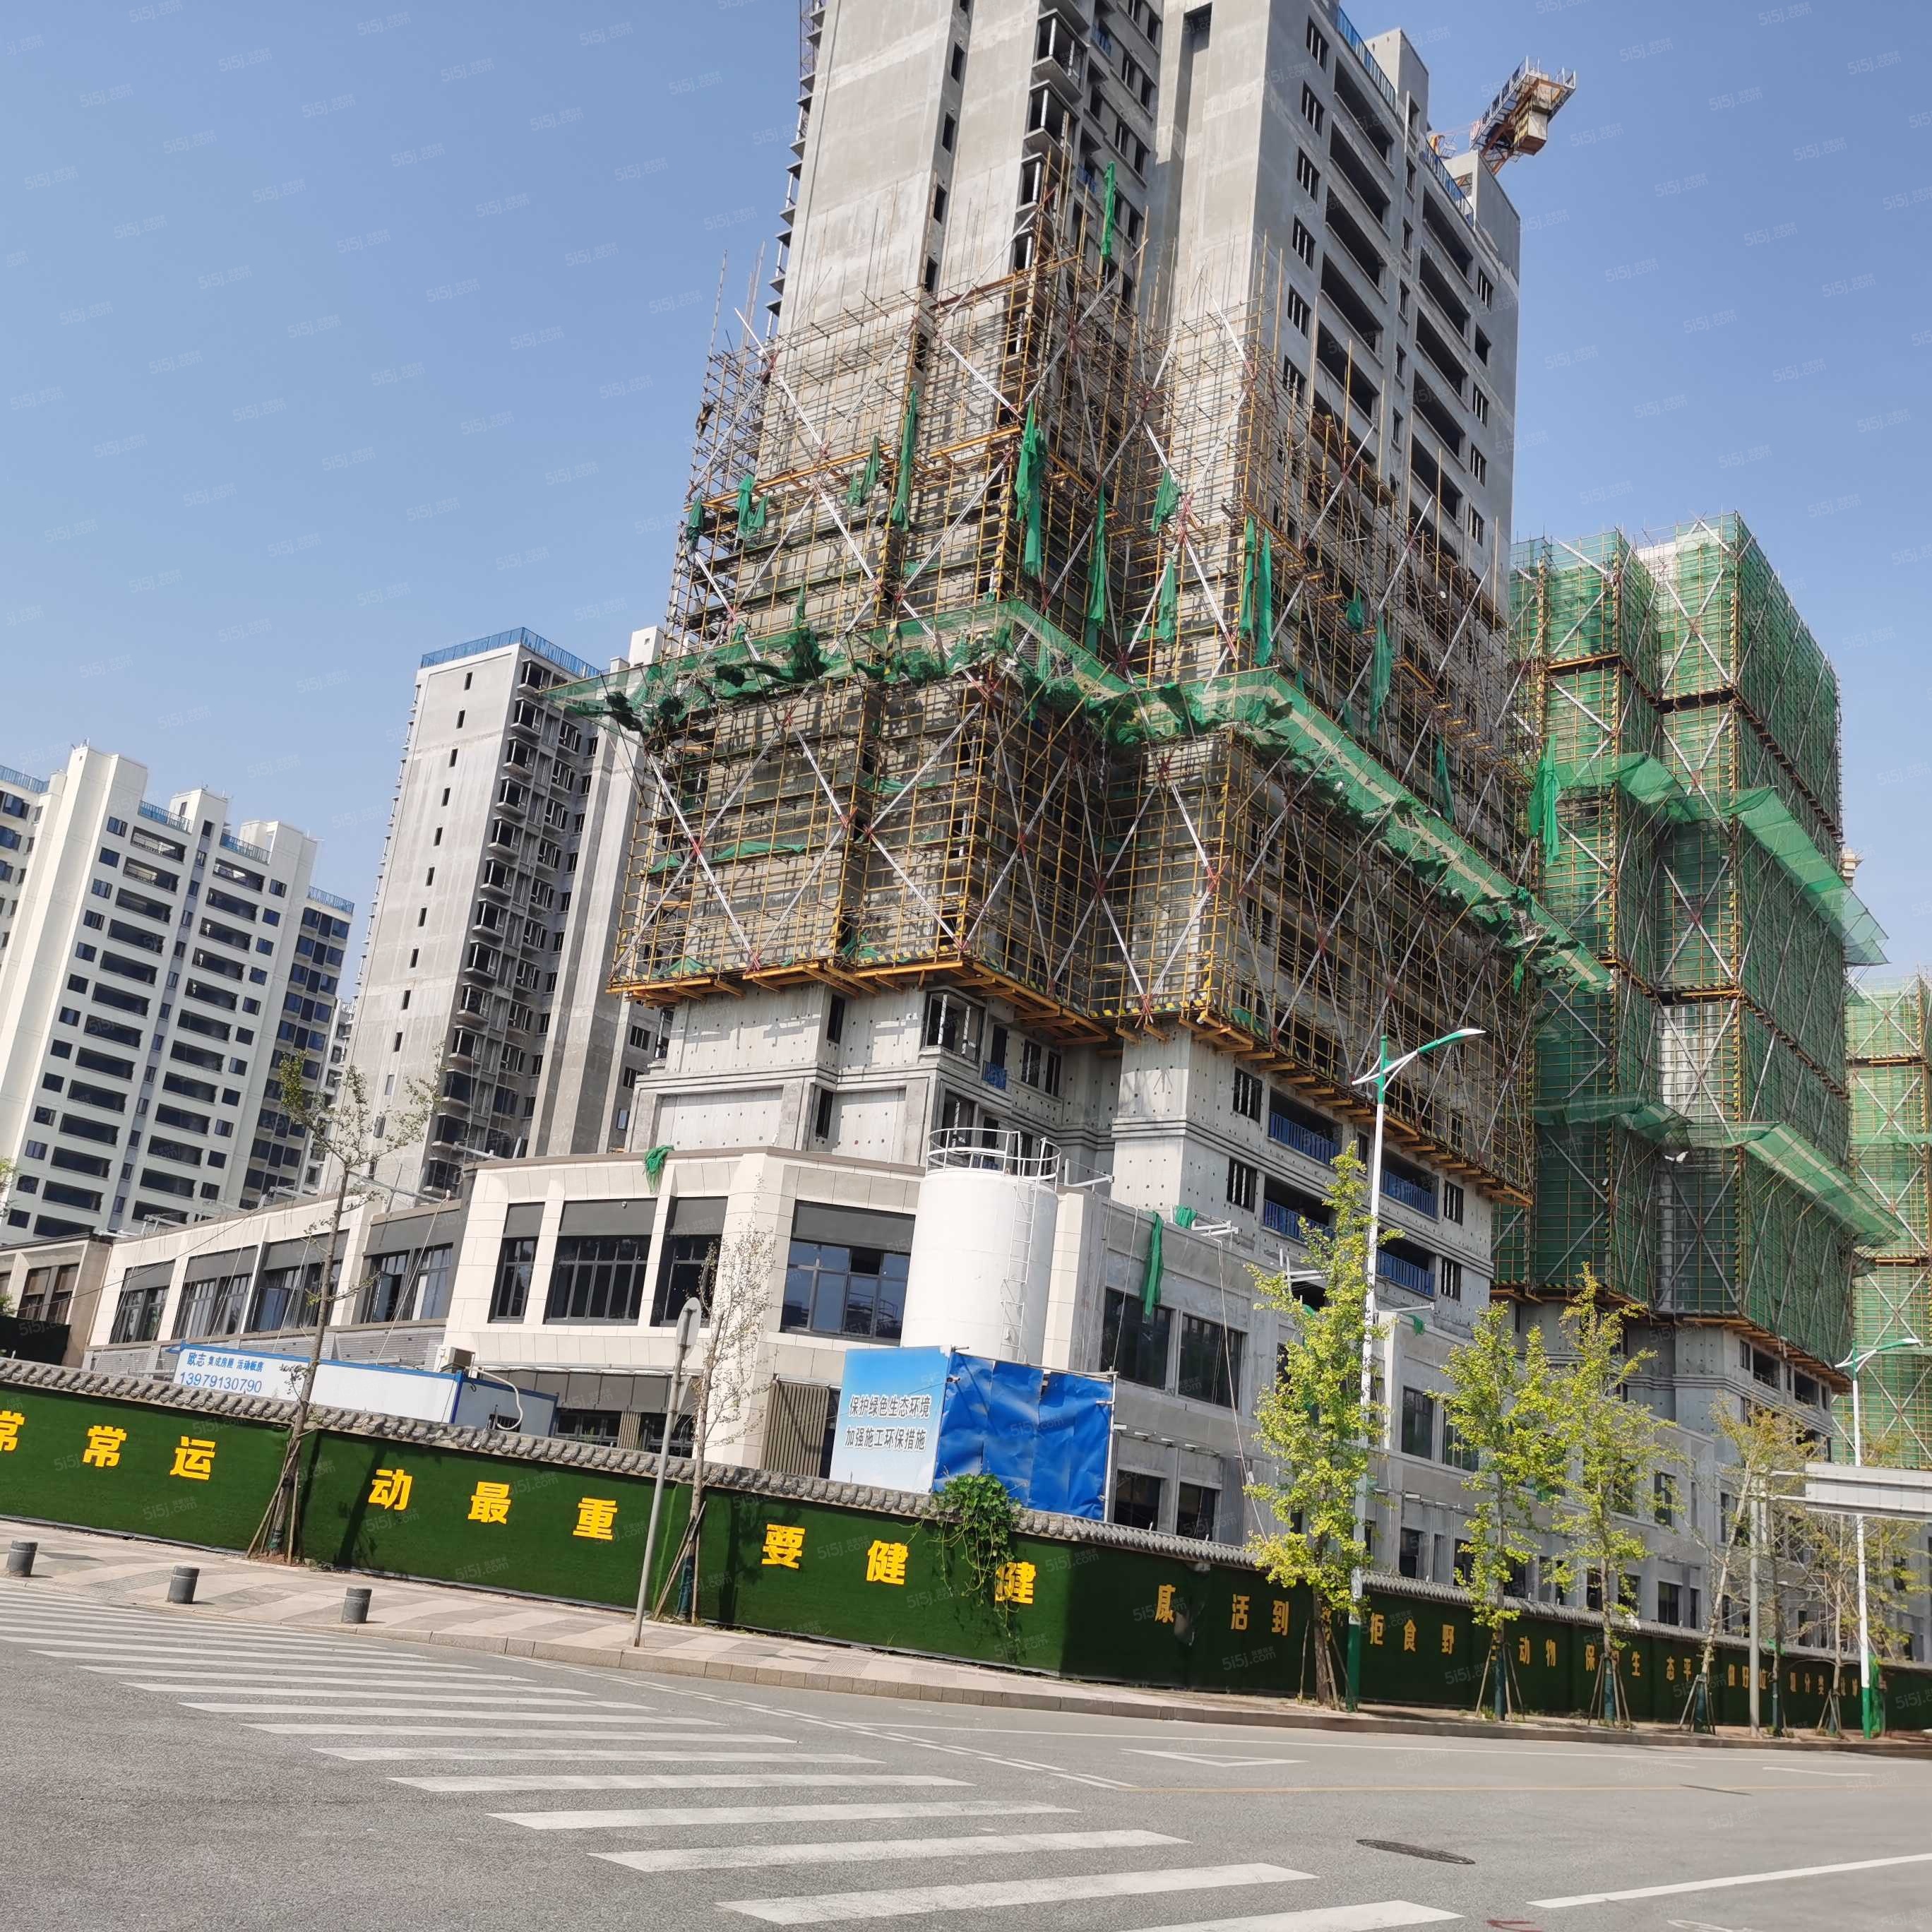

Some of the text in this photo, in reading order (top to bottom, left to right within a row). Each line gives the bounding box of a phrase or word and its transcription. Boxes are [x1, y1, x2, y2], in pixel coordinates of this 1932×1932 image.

[186, 1352, 264, 1372] 欧志 集成房屋 活动板房
[180, 1372, 262, 1393] 13979130790
[849, 1395, 931, 1418] 保护绿色生态环境
[845, 1426, 926, 1450] 加强施工环保措施
